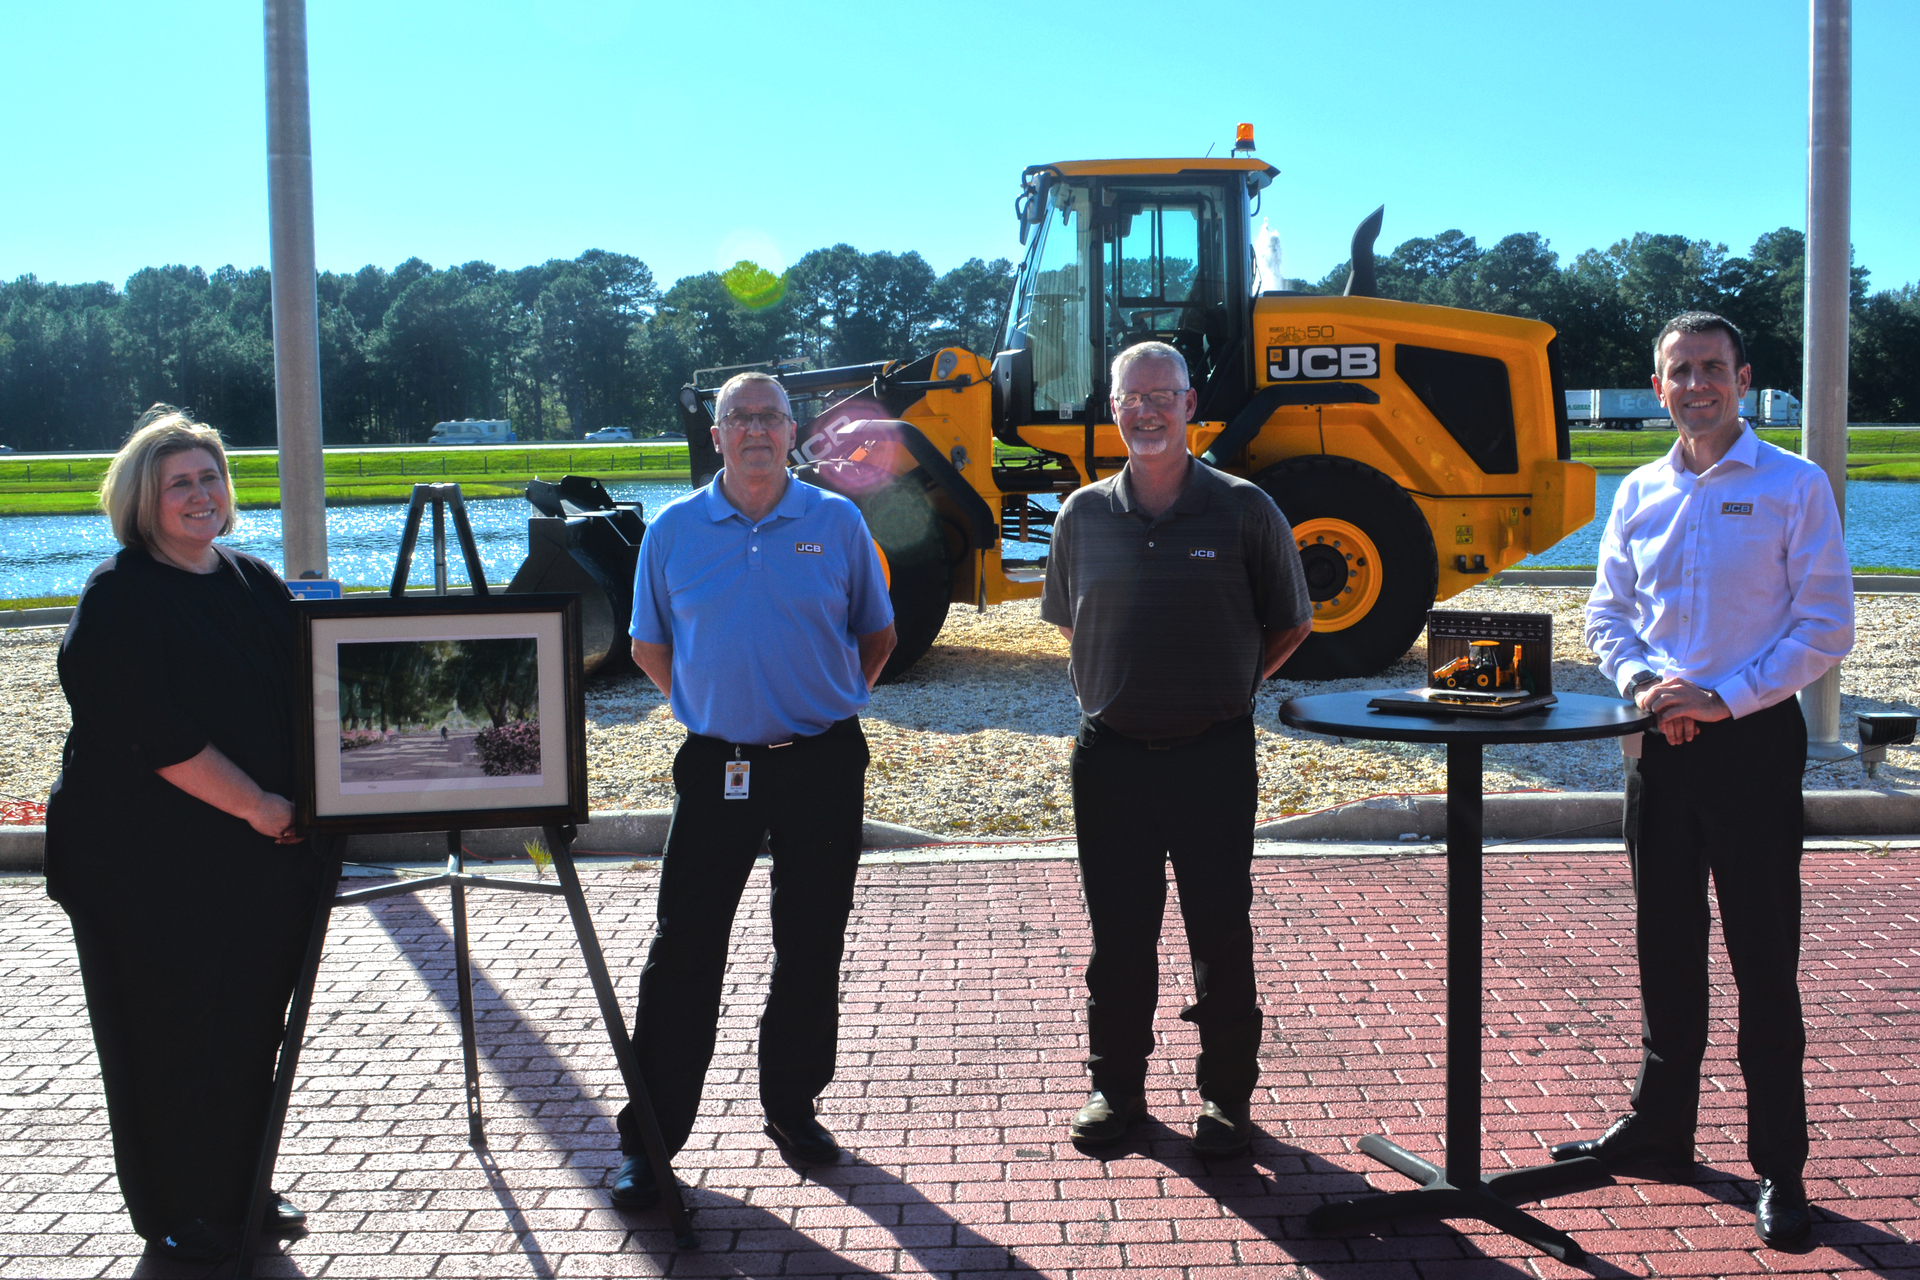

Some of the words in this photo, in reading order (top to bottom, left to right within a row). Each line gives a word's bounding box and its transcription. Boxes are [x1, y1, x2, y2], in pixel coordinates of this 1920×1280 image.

[1307, 325, 1335, 339] 50
[1269, 346, 1378, 379] JCB
[1724, 504, 1750, 513] JCB
[797, 544, 822, 553] JCB
[1190, 549, 1216, 558] JCB
